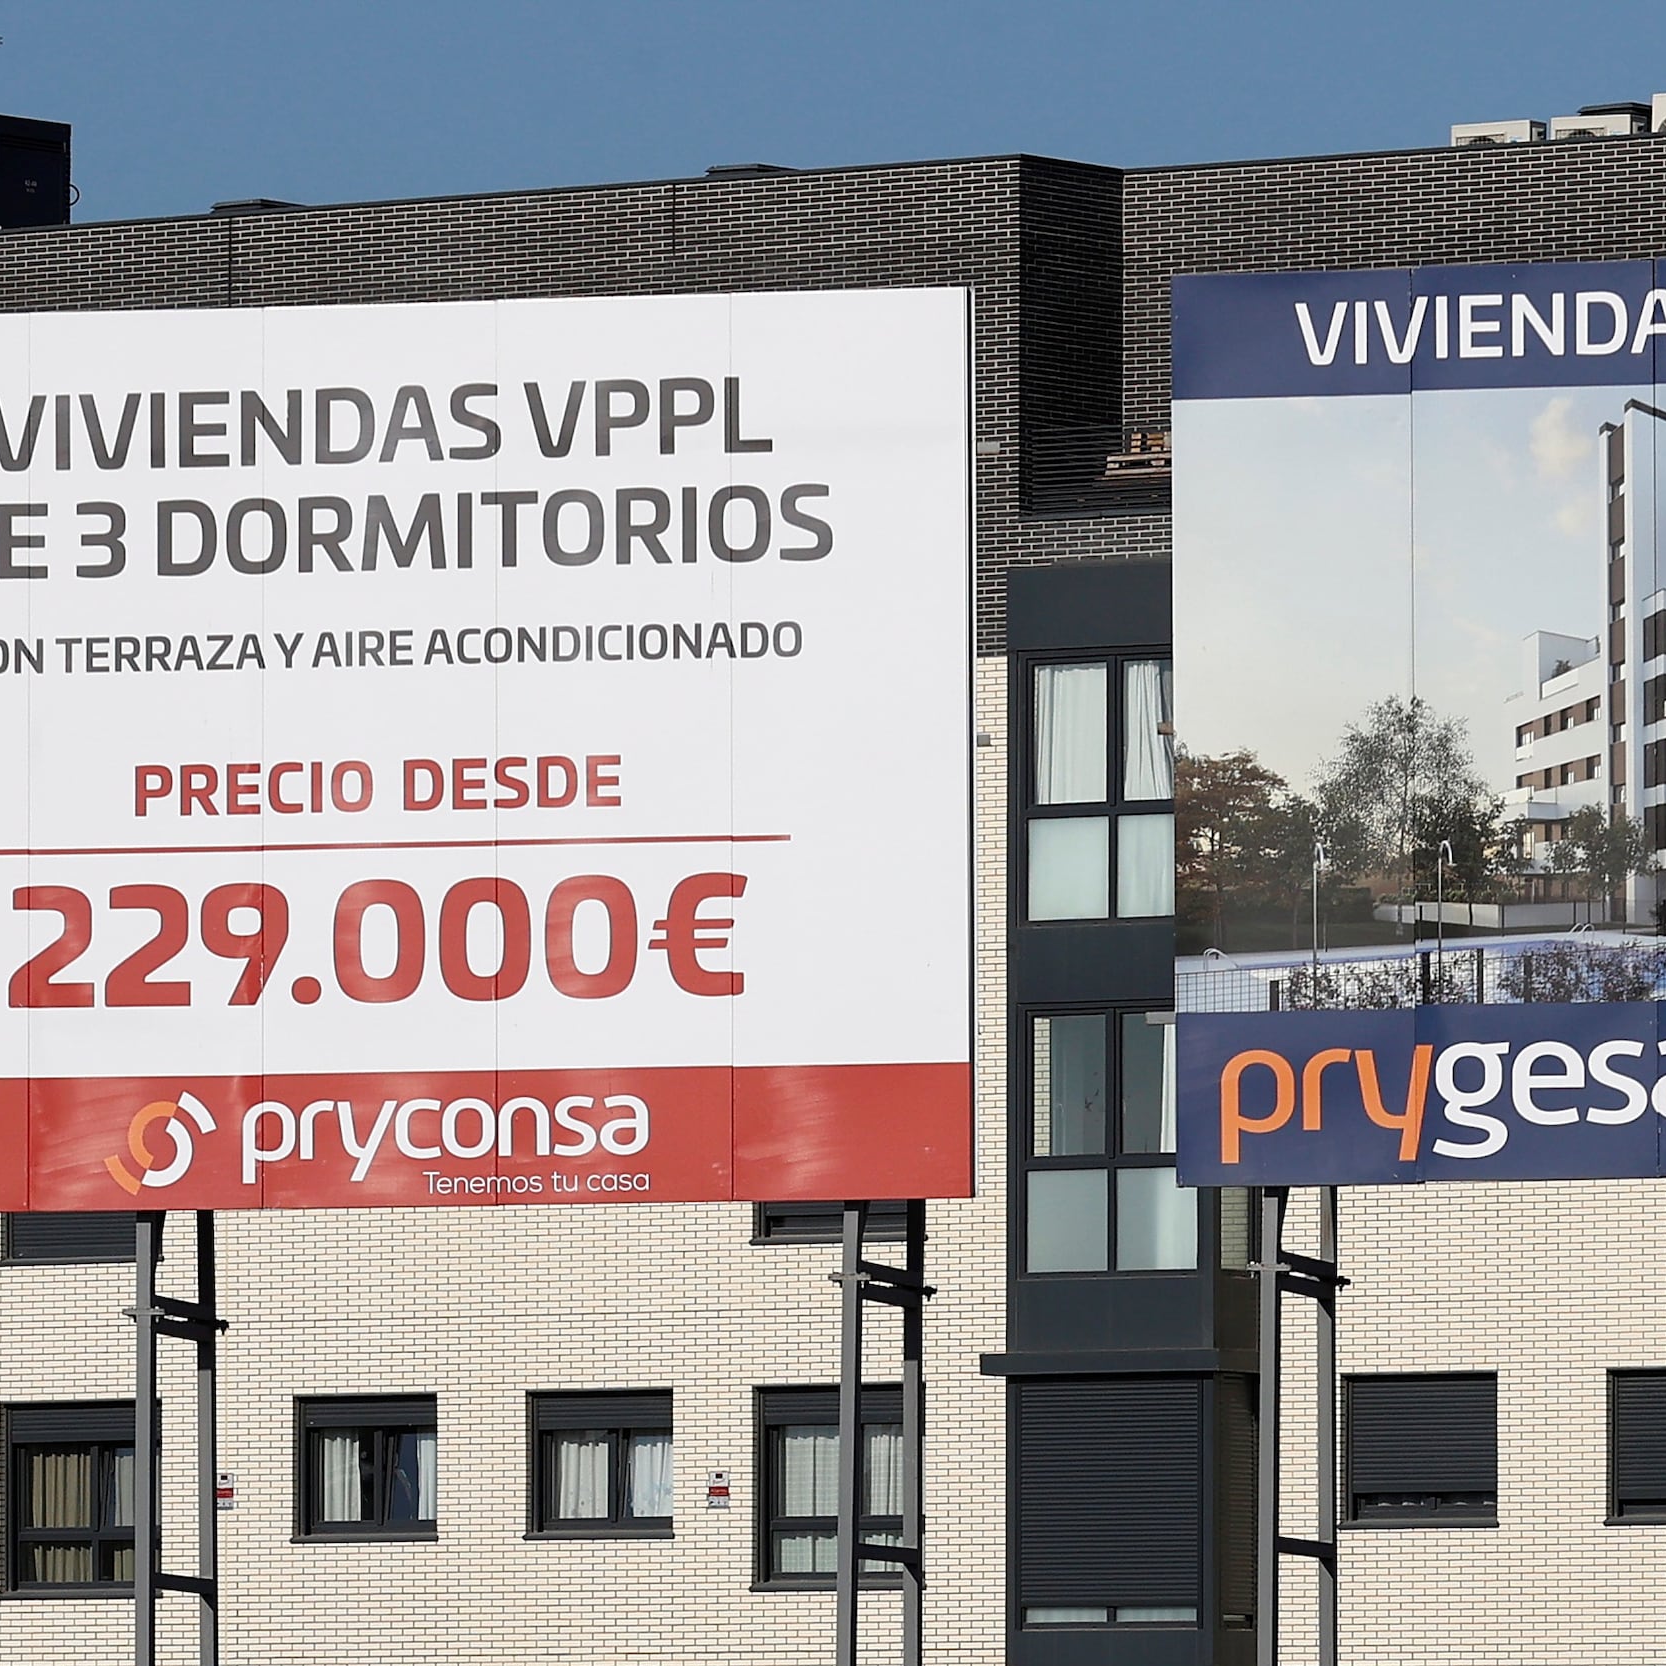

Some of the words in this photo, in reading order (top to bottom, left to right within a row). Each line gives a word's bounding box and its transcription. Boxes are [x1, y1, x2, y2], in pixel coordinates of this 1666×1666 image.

[524, 377, 772, 458] VPPL
[77, 502, 126, 578] 3
[157, 484, 833, 576] DORMITORIOS
[56, 634, 265, 673] TERRAZA
[274, 633, 304, 668] Y
[312, 630, 413, 667] AIRE
[424, 622, 802, 665] ACONDICIONADO
[135, 761, 373, 816] PRECIO
[403, 755, 621, 811] DESDE
[8, 872, 748, 1008] 229.000€
[243, 1093, 648, 1183] pryconsa
[423, 1167, 542, 1197] Tenemos
[551, 1172, 577, 1192] tu
[587, 1173, 650, 1192] casa
